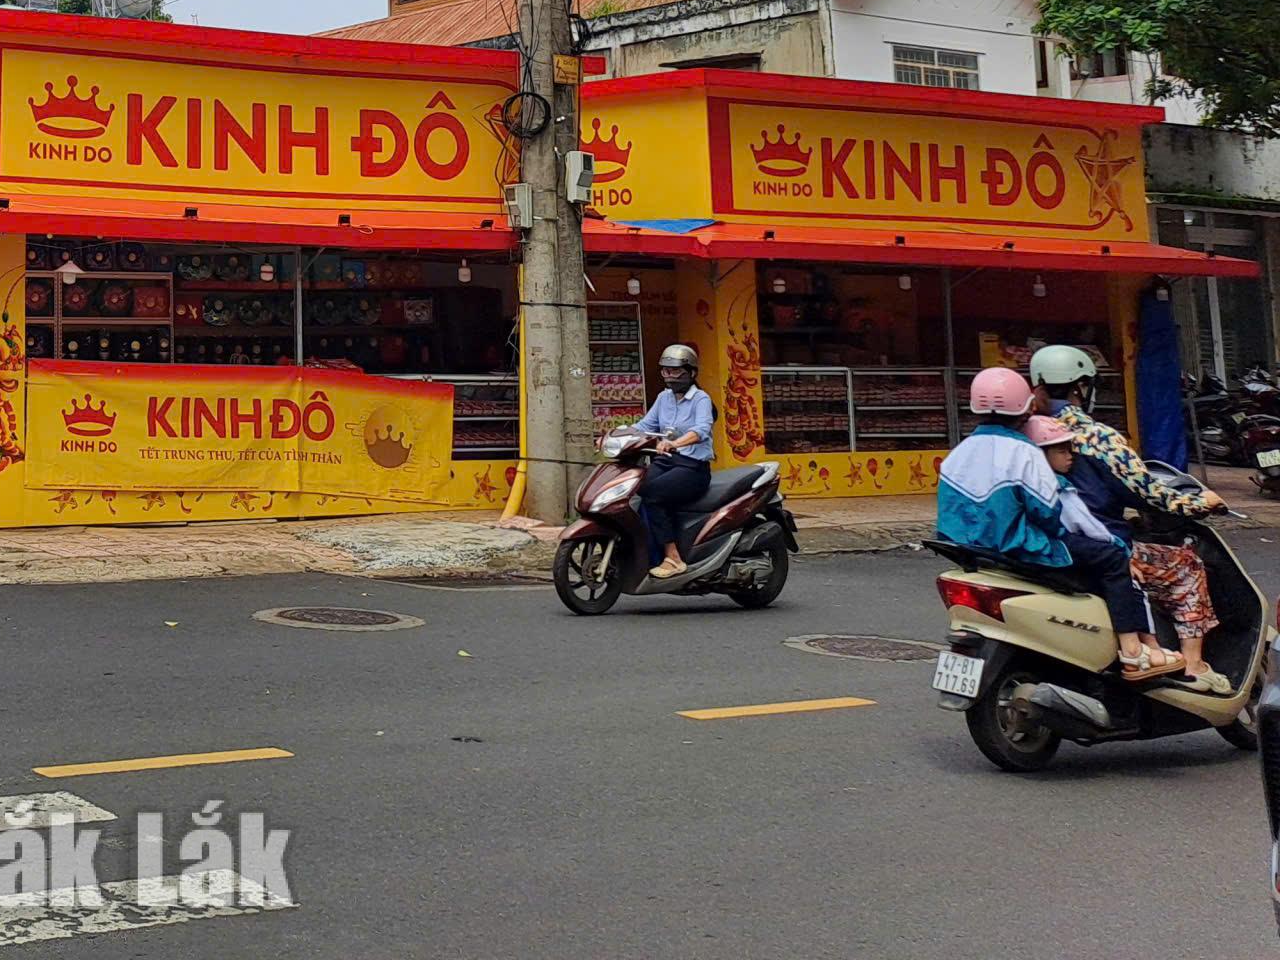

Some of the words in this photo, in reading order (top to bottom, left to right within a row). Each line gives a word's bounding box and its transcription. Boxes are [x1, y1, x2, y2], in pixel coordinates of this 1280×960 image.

[126, 91, 331, 177] KINH
[350, 90, 471, 182] ĐÔ
[28, 142, 77, 162] KINH
[82, 145, 114, 164] DO
[819, 135, 969, 206] KINH
[979, 133, 1070, 211] ĐÔ
[608, 188, 633, 207] DO
[752, 180, 788, 197] KINH
[790, 182, 814, 198] DO
[146, 396, 263, 440] KINH
[267, 390, 336, 442] ĐÔ
[60, 440, 95, 453] KINH
[97, 440, 118, 453] DO
[139, 447, 161, 460] TẾT
[163, 449, 205, 461] TRUNG
[207, 451, 235, 462] THU,
[238, 448, 257, 461] TẾT
[258, 447, 282, 461] CỦA
[310, 451, 342, 465] THÂN
[936, 671, 976, 695] 717.69
